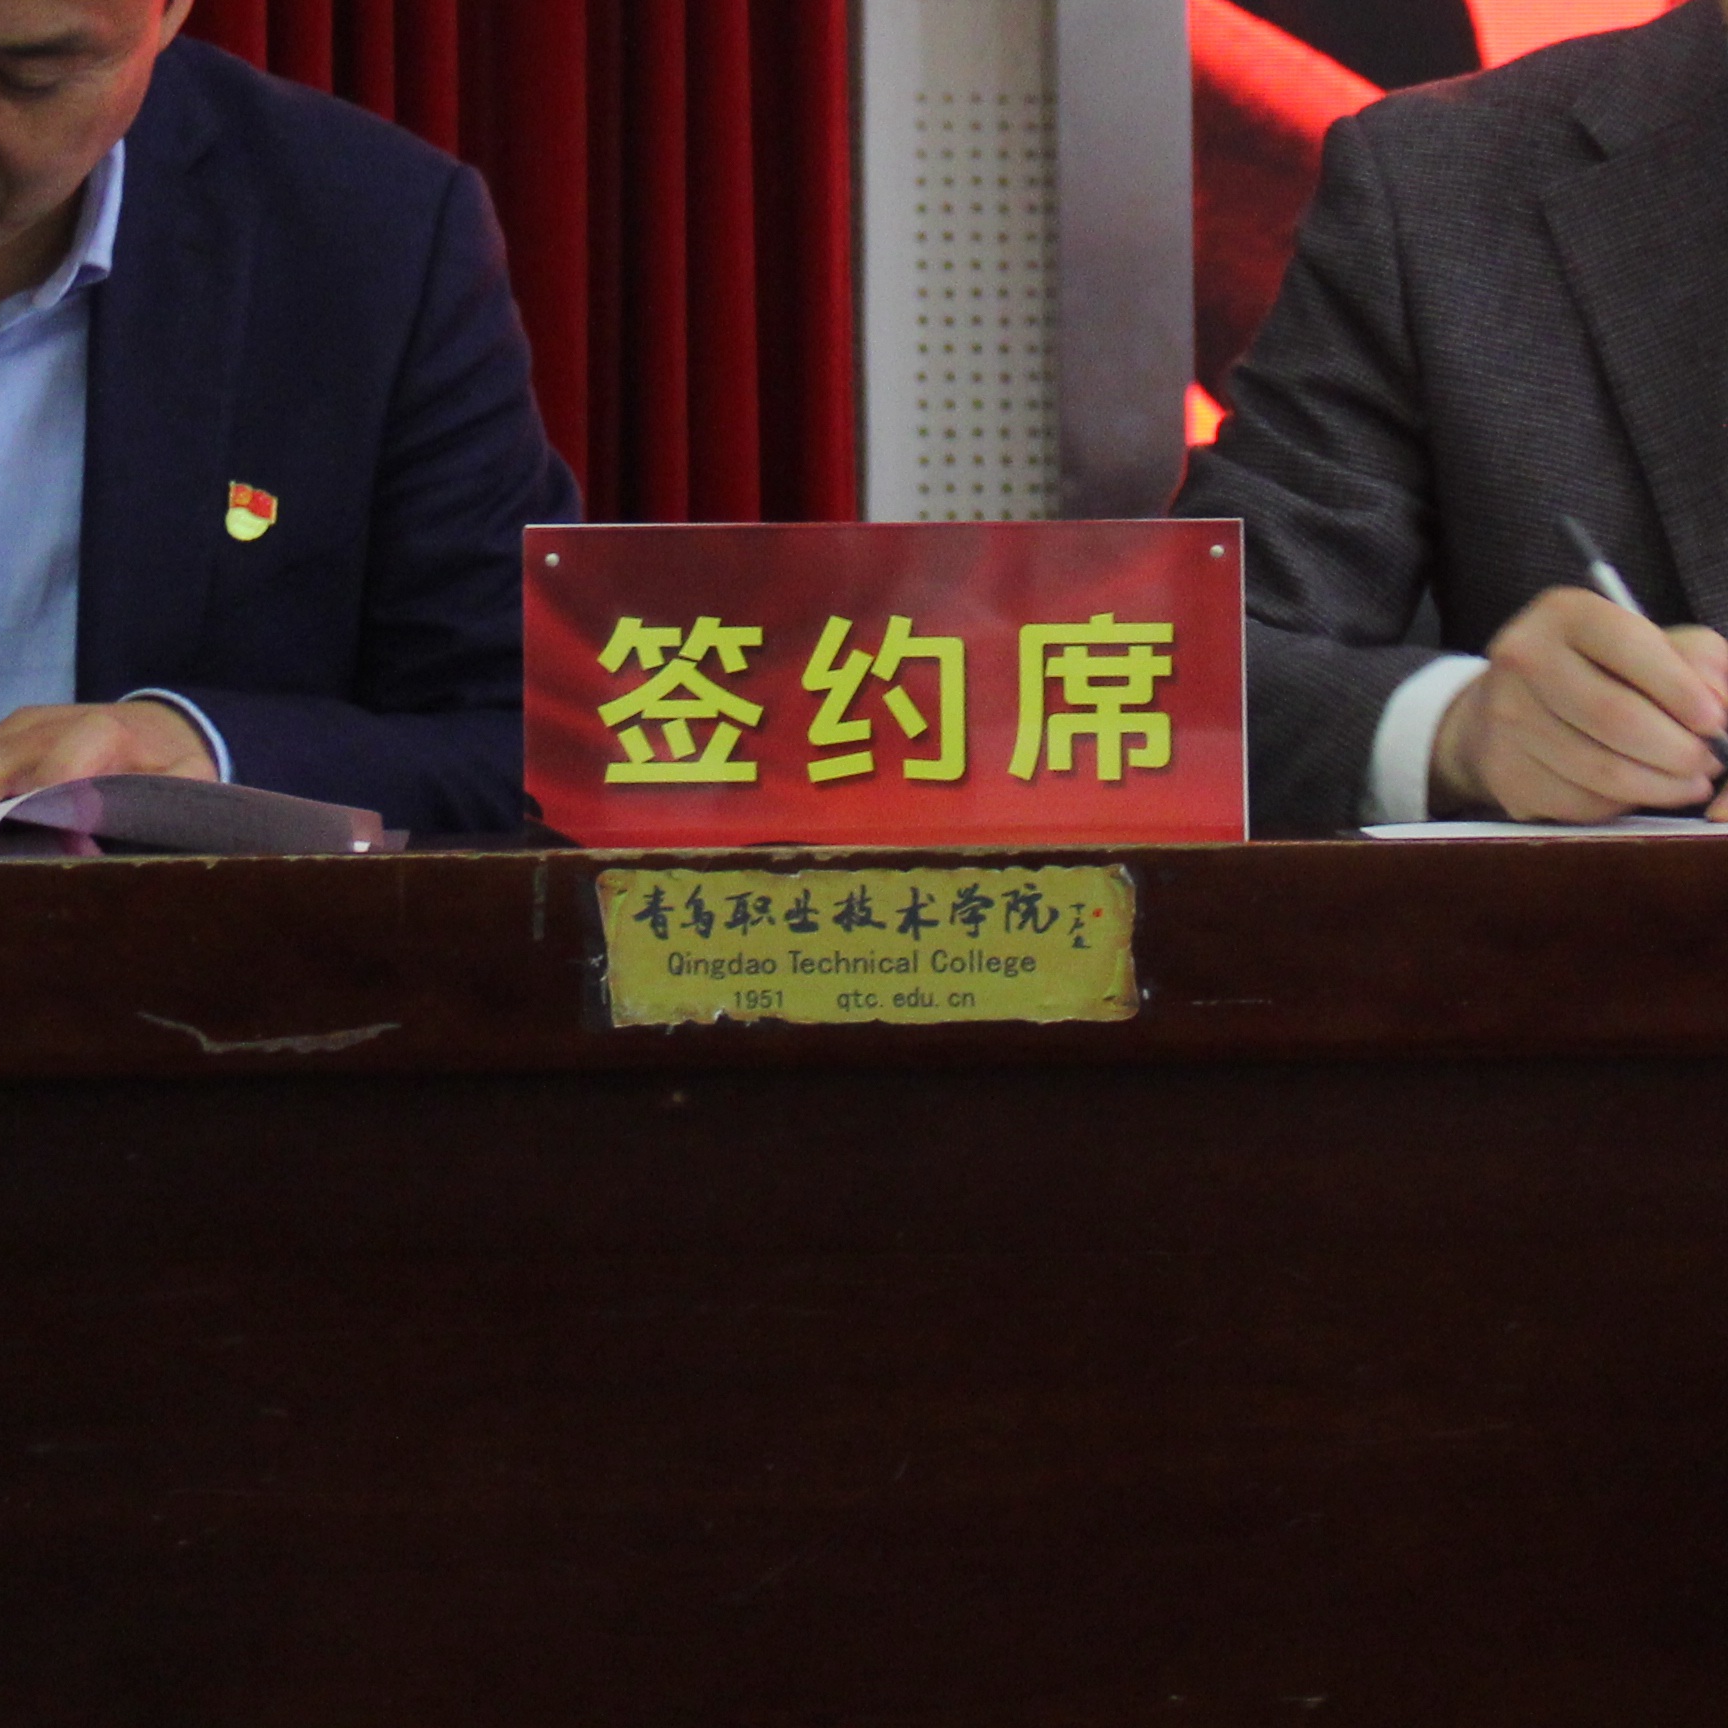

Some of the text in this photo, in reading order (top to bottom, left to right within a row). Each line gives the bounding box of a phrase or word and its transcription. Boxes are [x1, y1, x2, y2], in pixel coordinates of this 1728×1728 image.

[596, 612, 1174, 784] 签约席
[667, 948, 1037, 980] Qingdao Technical College
[733, 989, 785, 1010] 1951
